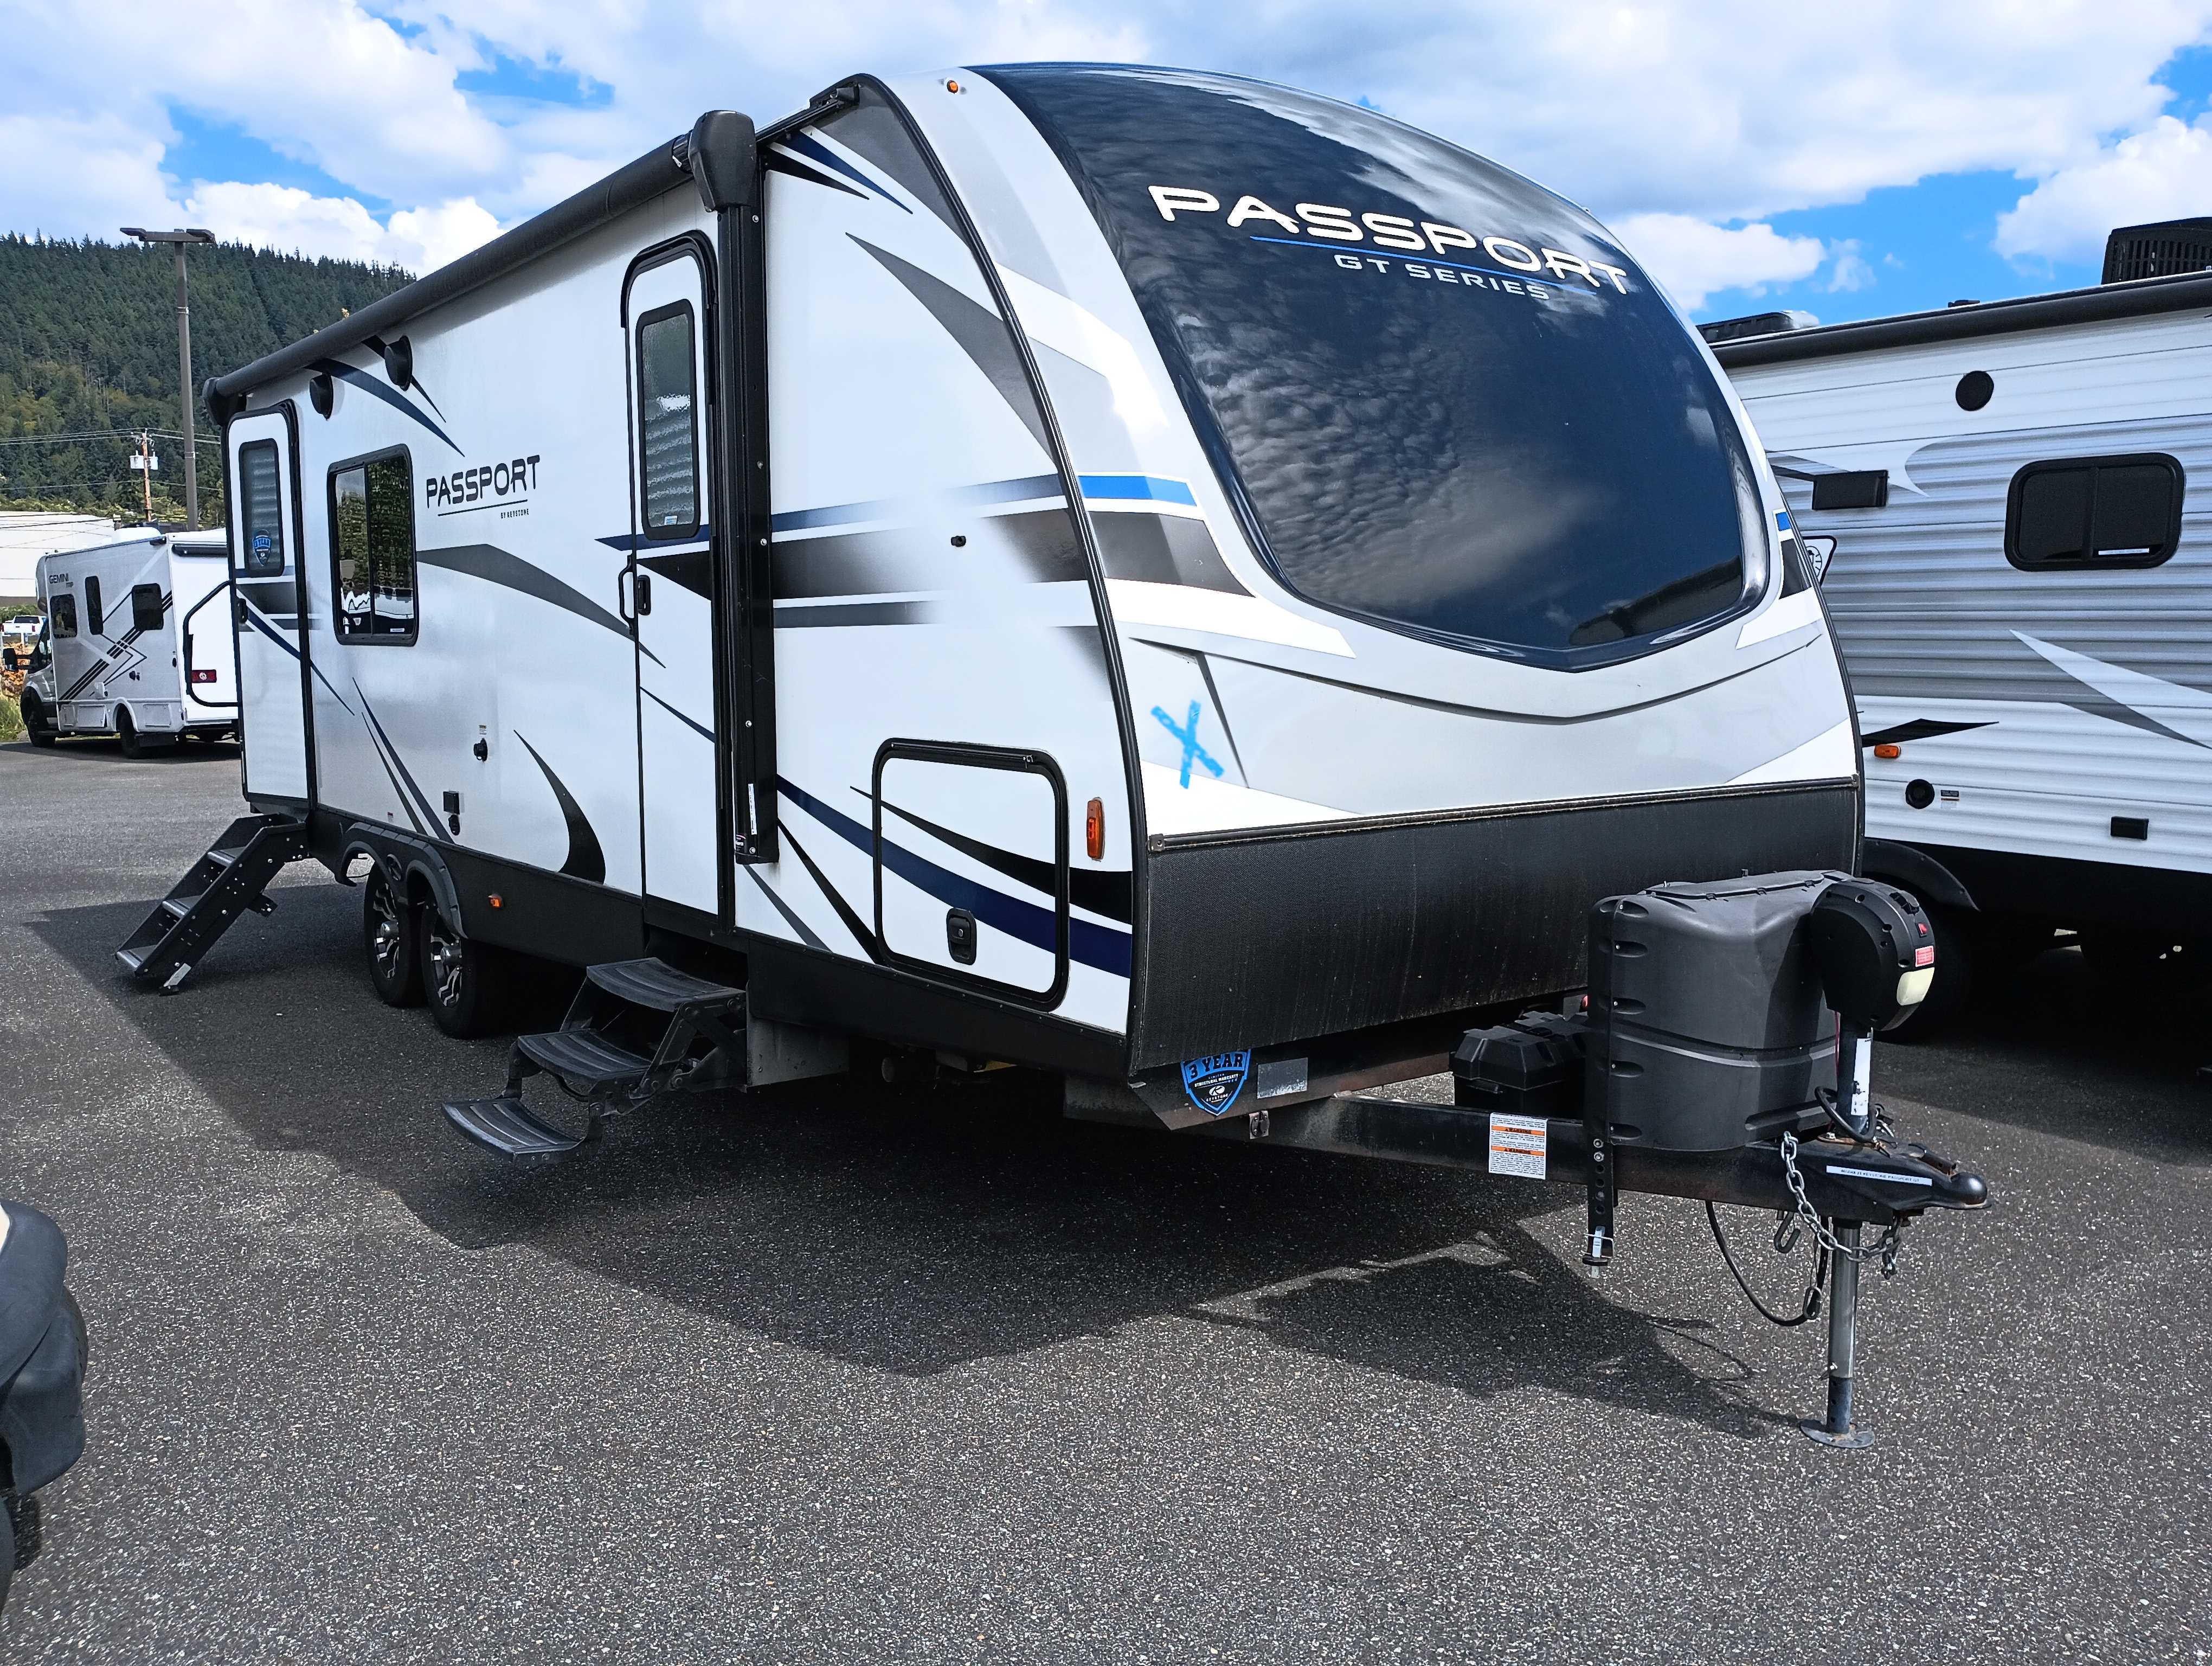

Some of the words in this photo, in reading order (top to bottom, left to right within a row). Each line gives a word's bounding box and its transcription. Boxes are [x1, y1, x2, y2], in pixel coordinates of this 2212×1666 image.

[1148, 185, 1627, 294] PASSPORT
[1334, 254, 1390, 273] GT
[1404, 264, 1550, 300] SERIES
[426, 454, 540, 509] PASSPORT
[1188, 1063, 1198, 1079] 3
[1202, 1053, 1243, 1072] YEAR
